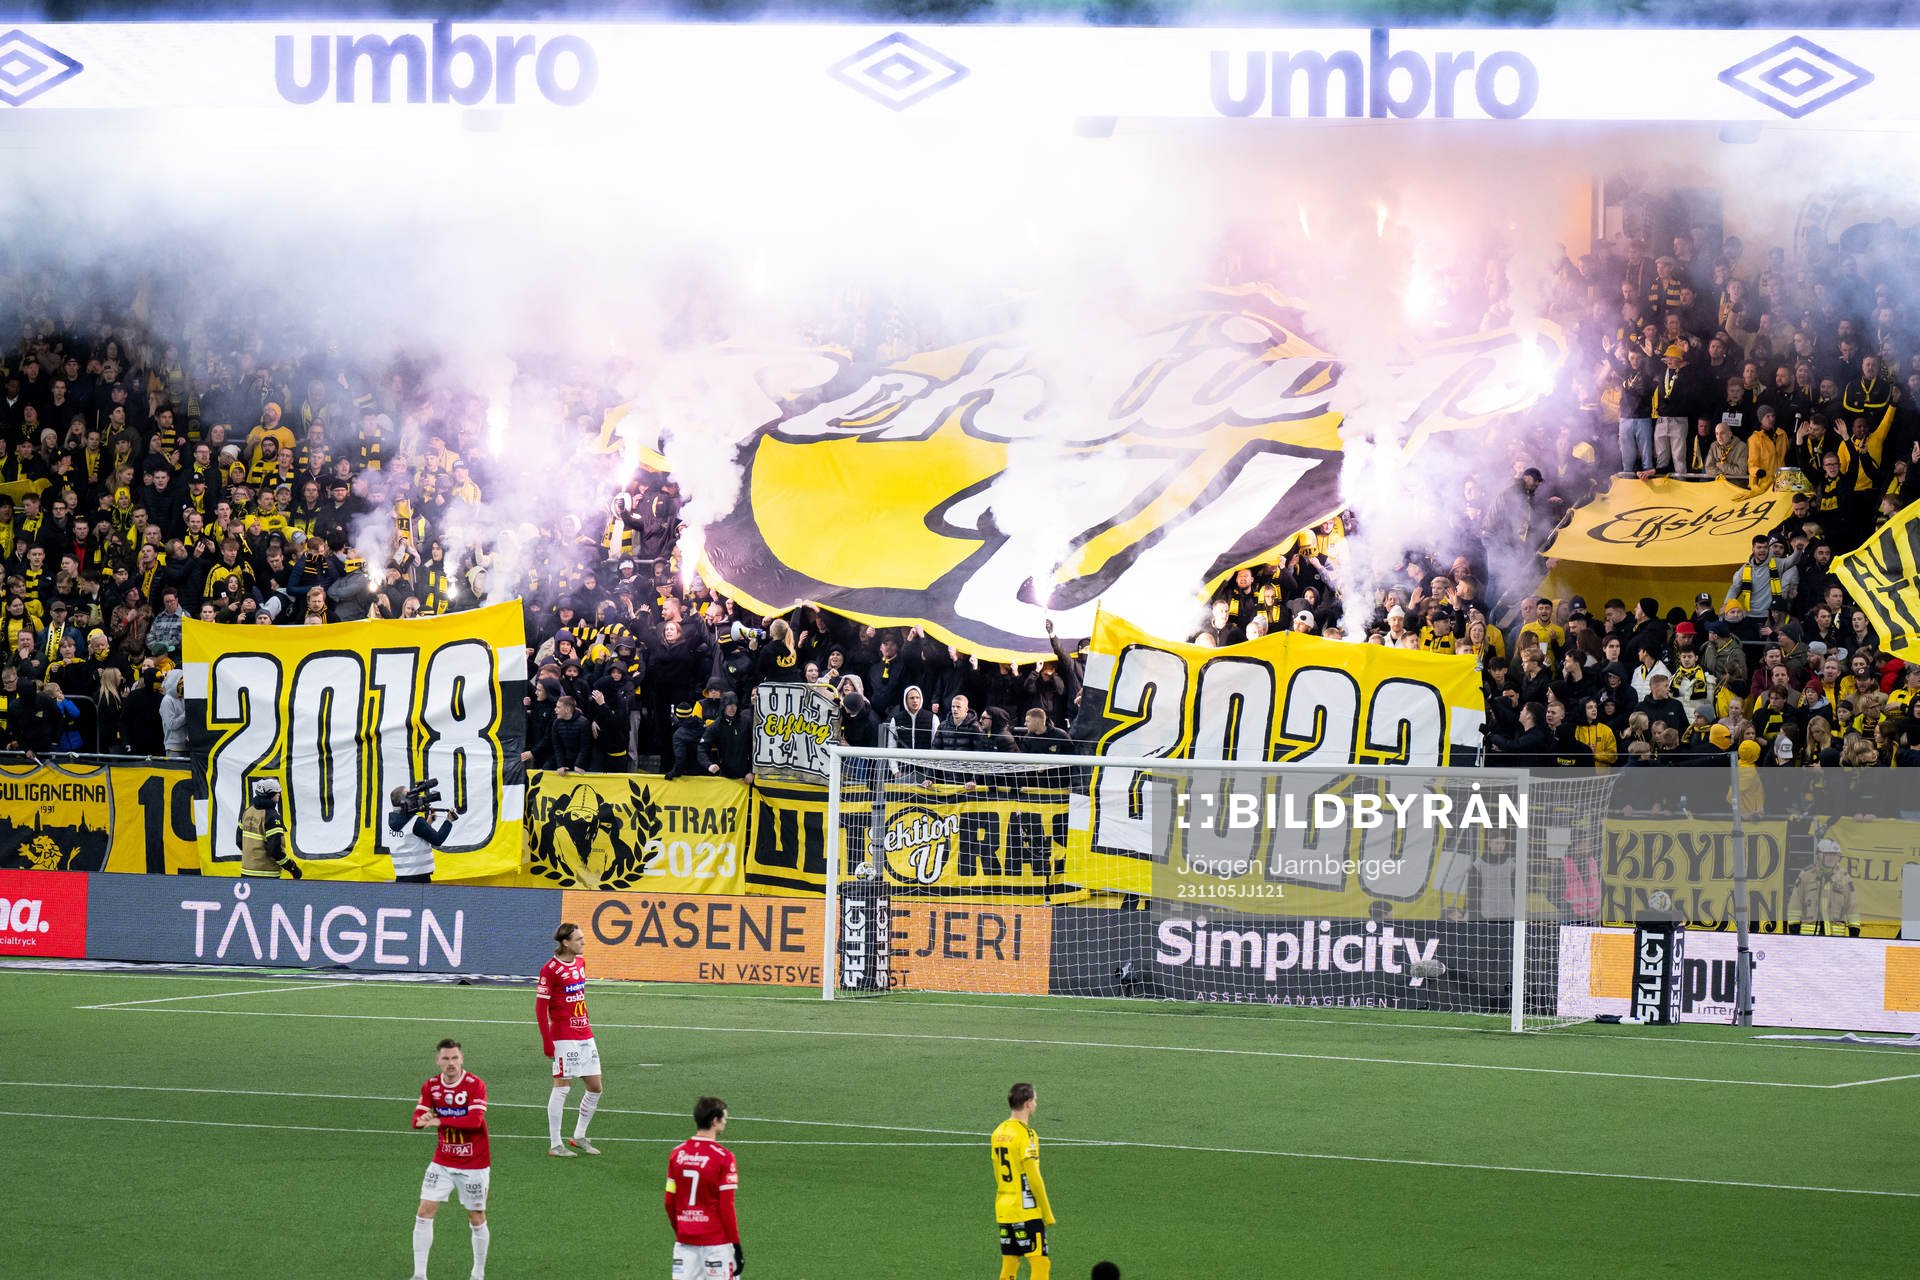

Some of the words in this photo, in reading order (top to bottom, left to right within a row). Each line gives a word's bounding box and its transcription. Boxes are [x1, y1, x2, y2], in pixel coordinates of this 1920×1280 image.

[275, 22, 598, 106] umbro
[1210, 29, 1539, 120] umbro
[1587, 500, 1776, 548] Elfsborg
[210, 638, 498, 862] 2018
[1091, 644, 1446, 902] 2023
[0, 783, 106, 803] ULIGANERNA
[40, 805, 55, 814] 1991
[643, 840, 736, 878] 2023
[909, 843, 945, 884] U
[1606, 831, 1780, 882] KRYDD
[1839, 853, 1920, 883] ELL
[181, 882, 464, 968] TÅNGEN
[592, 899, 806, 953] GÄSENE
[838, 909, 1021, 960] EJERI
[844, 899, 866, 987] SELECT
[876, 899, 889, 987] SELECT
[1156, 916, 1439, 986] Simplicity
[700, 962, 725, 980] EN
[737, 963, 822, 984] VÄSTSVE
[1196, 992, 1256, 1004] ASSET
[1267, 994, 1400, 1009] MANAGEMENT
[1637, 930, 1664, 1022] SELECT
[1670, 931, 1684, 1023] SELECT
[683, 1169, 700, 1206] 7
